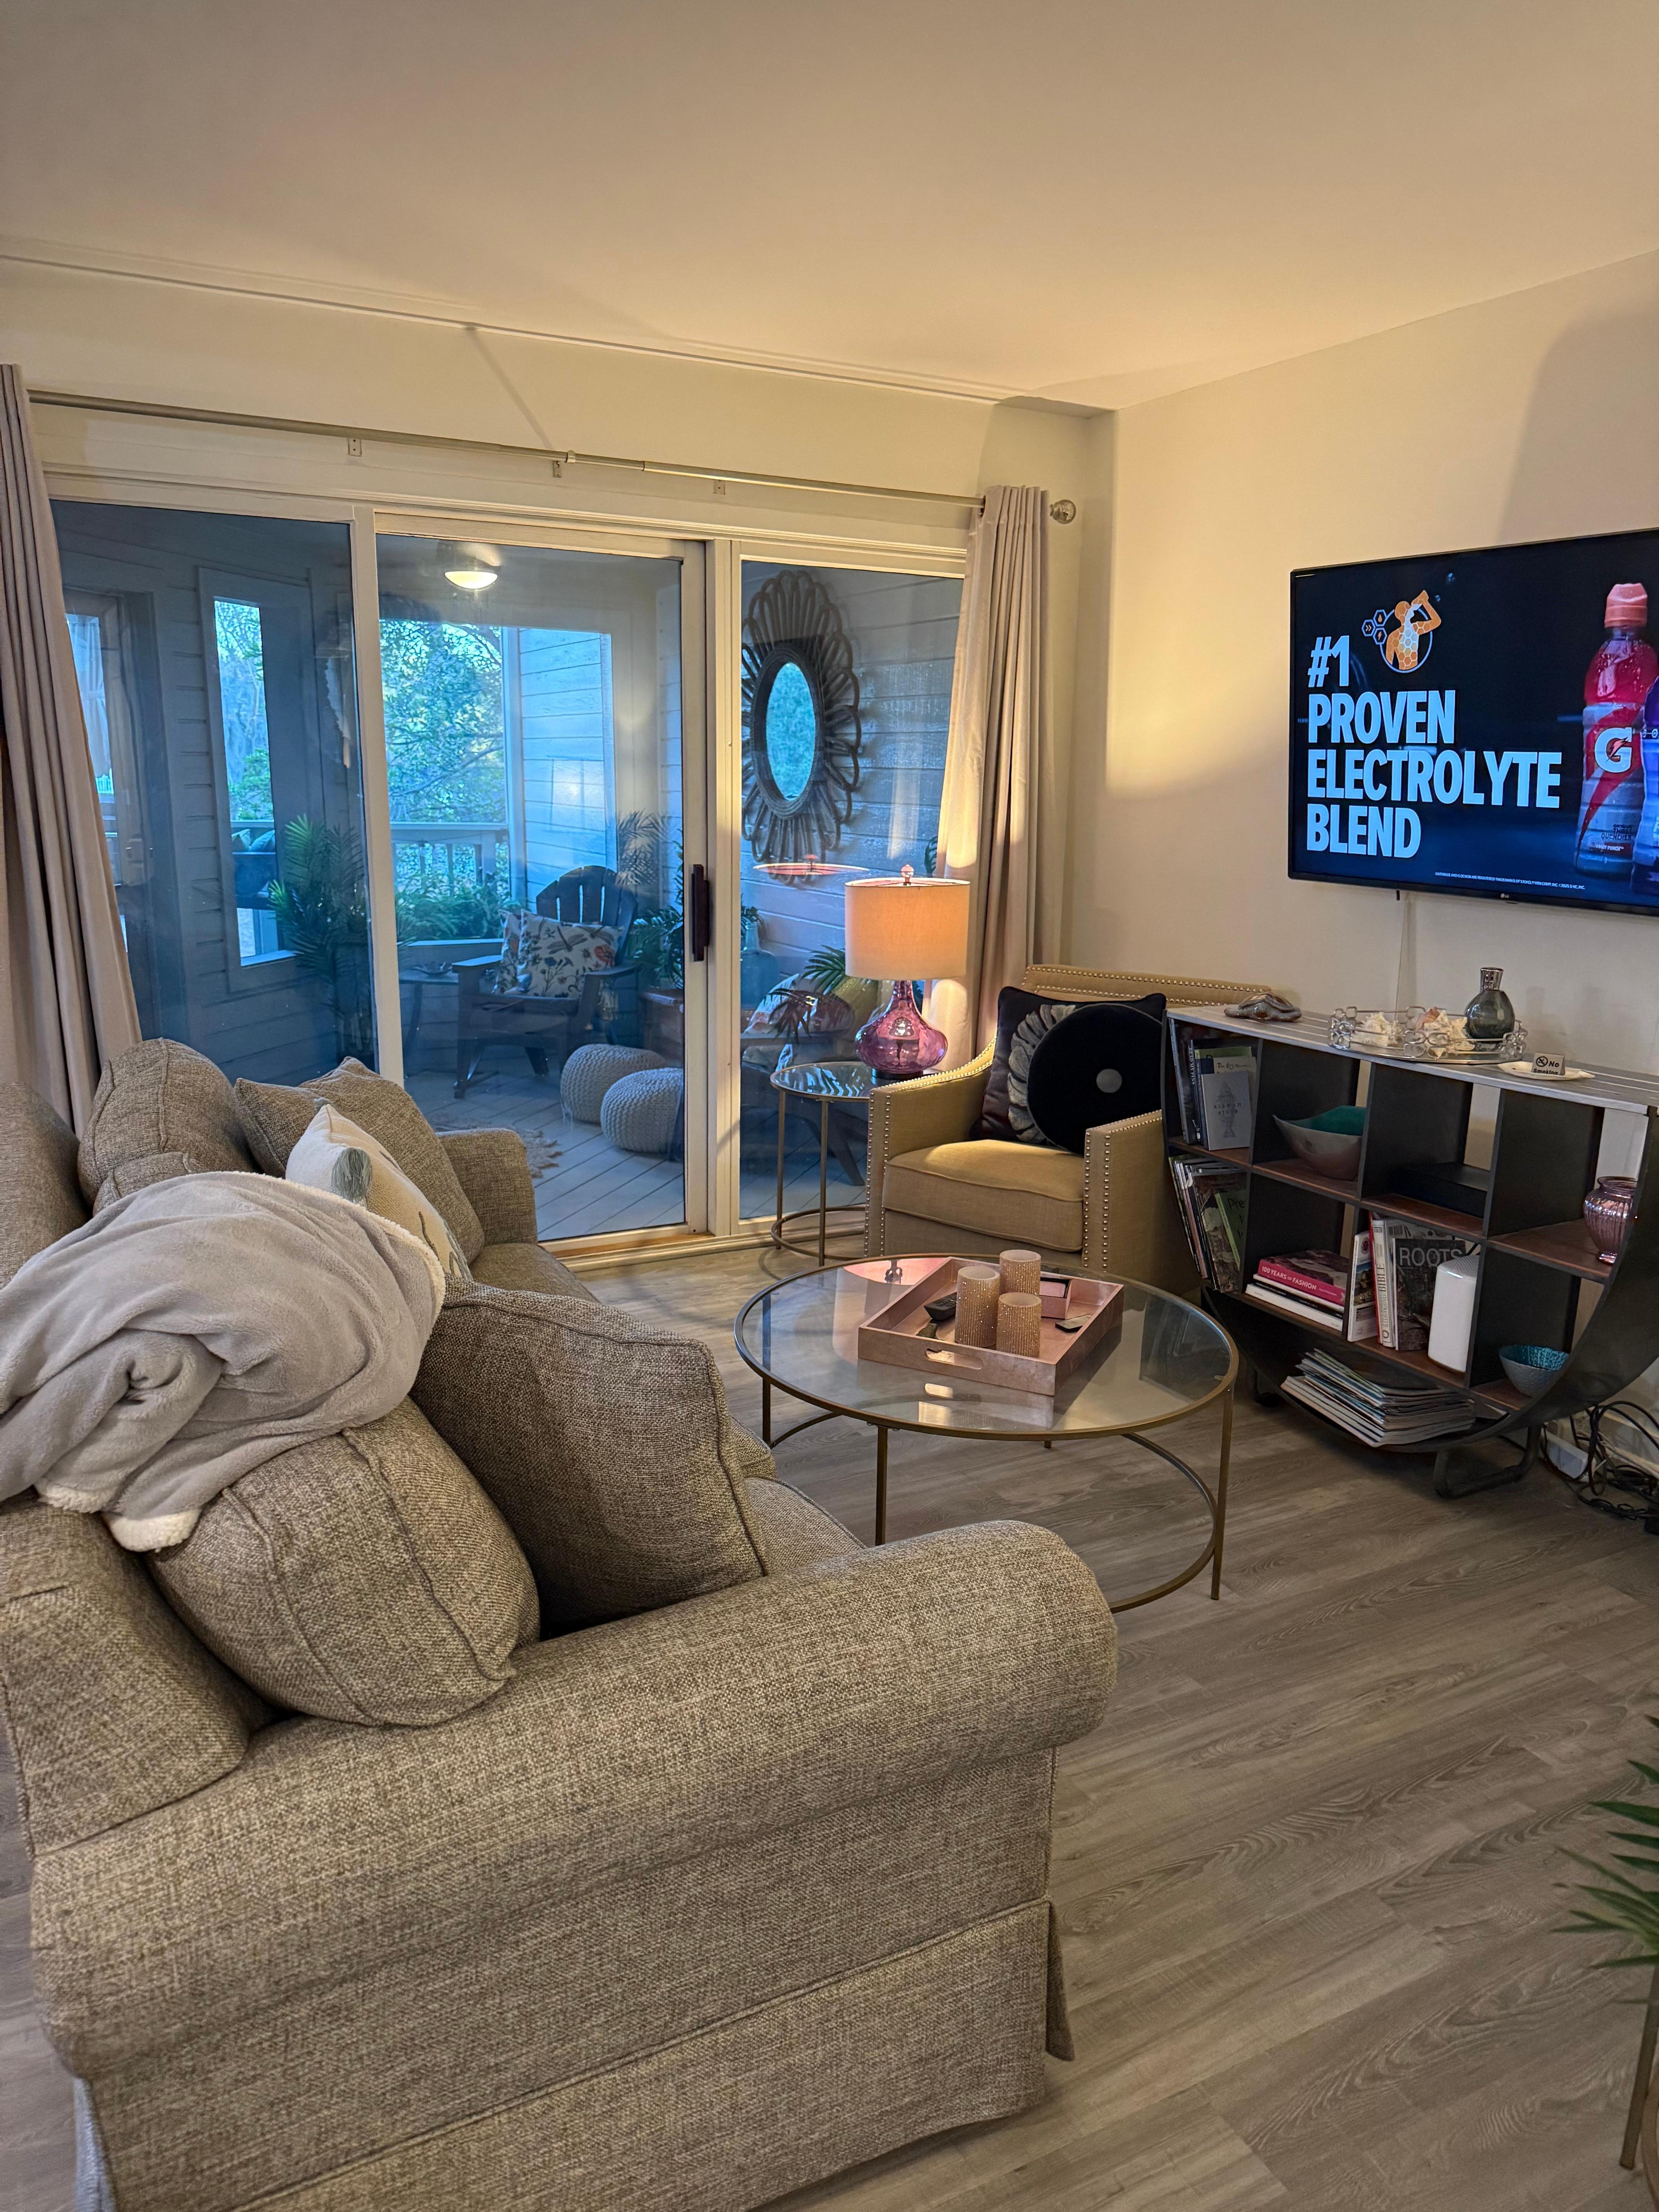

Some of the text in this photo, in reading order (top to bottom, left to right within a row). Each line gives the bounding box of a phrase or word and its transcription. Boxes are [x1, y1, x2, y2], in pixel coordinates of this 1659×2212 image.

[1307, 635, 1350, 687] #1
[1308, 690, 1456, 744] PROVEN
[1594, 727, 1632, 773] G
[1308, 749, 1562, 808] ELECTROLYTE
[1307, 804, 1421, 858] BLEND
[1271, 1269, 1287, 1280] YEARS
[1292, 1278, 1317, 1290] FASHION
[1377, 1263, 1386, 1292] BIBLE
